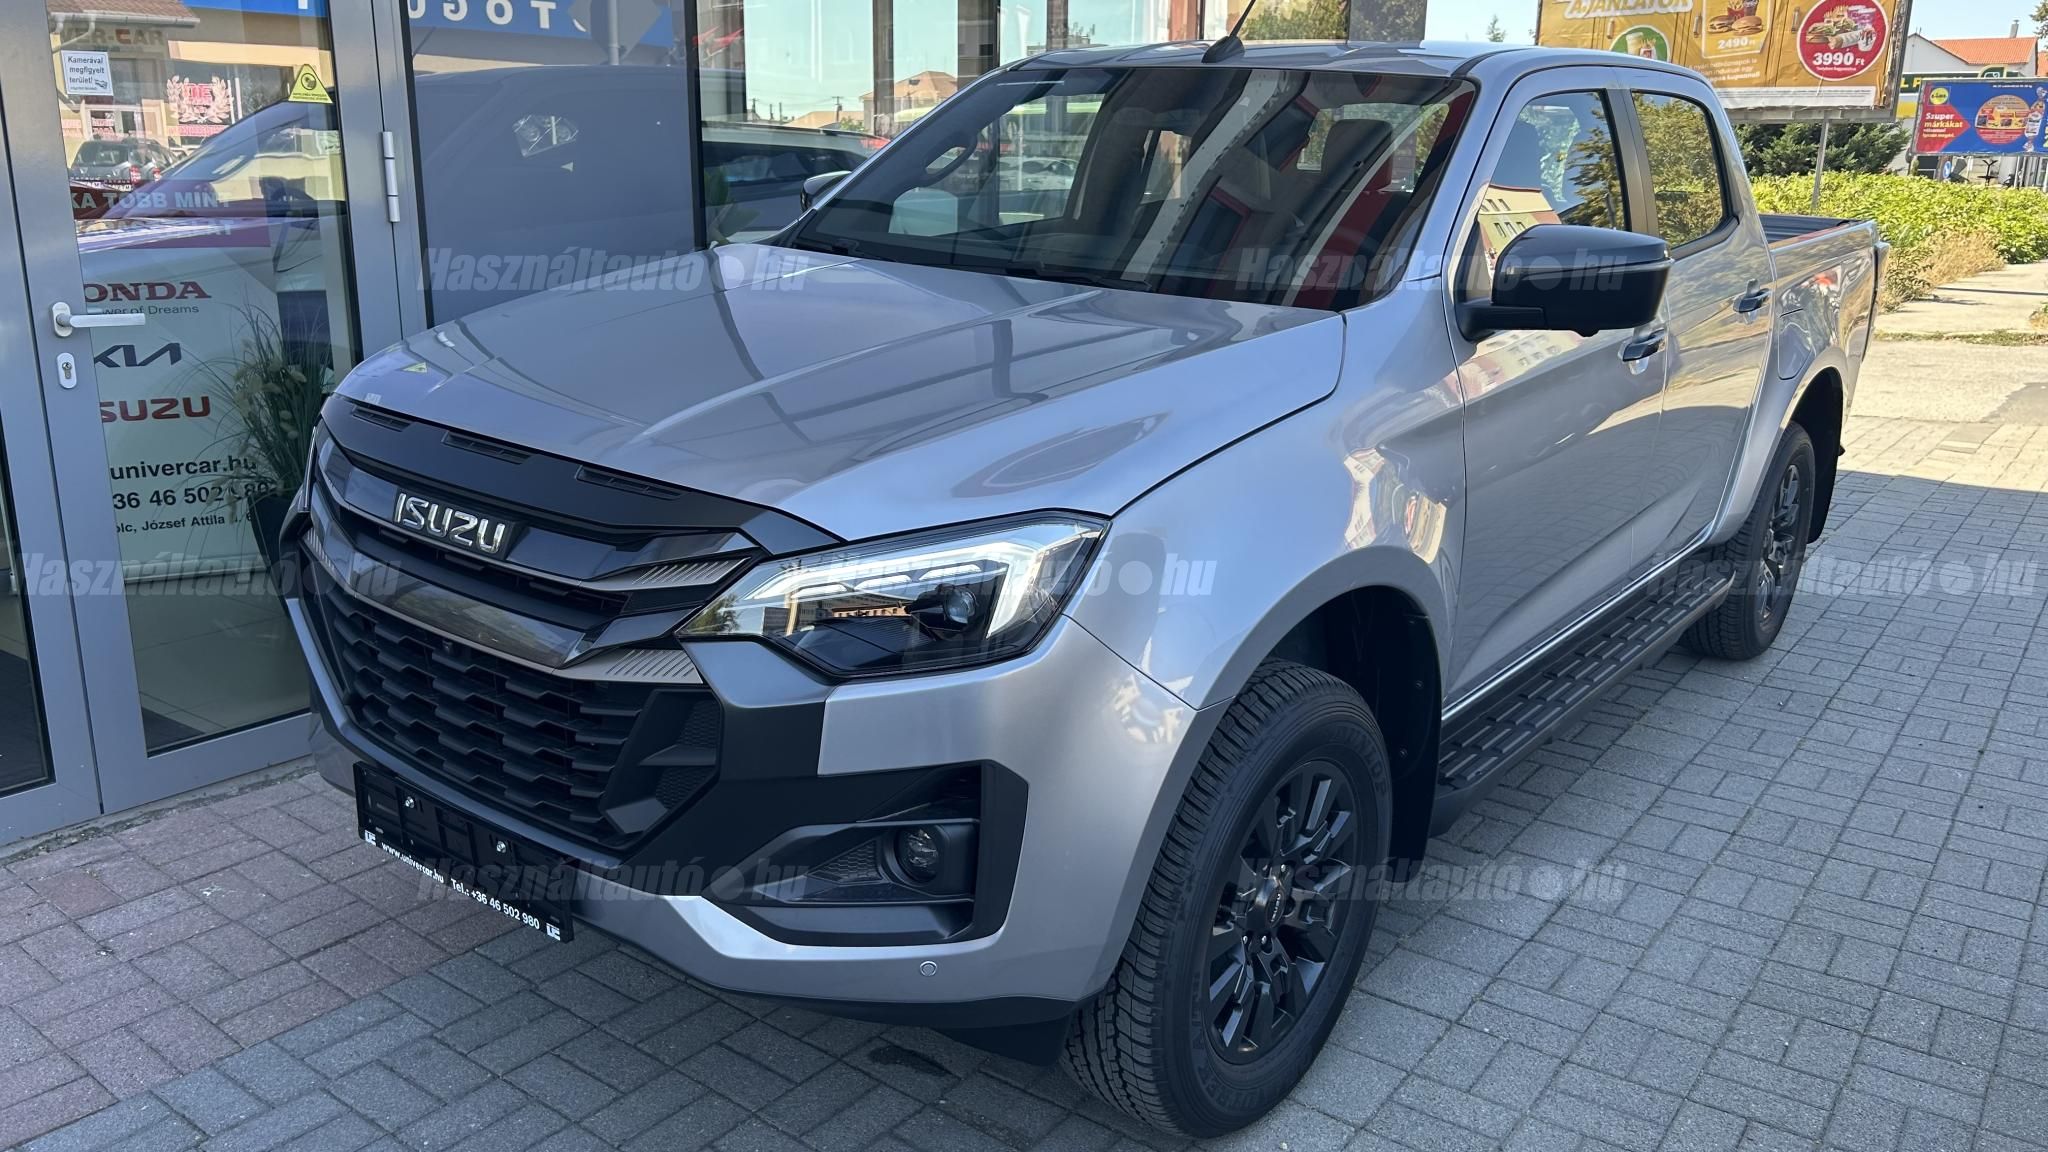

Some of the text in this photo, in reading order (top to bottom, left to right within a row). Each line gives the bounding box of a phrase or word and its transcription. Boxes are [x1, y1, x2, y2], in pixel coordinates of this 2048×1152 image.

[1717, 36, 1749, 50] 2490
[1812, 51, 1855, 66] 3990
[83, 281, 212, 303] ONDA
[148, 304, 200, 315] Dreams
[99, 396, 211, 423] SUZU
[150, 489, 177, 506] 46
[142, 517, 186, 532] József
[191, 514, 225, 527] Attila
[394, 492, 506, 554] ISUZU
[381, 842, 540, 931] www.univercar.hu Tel.: +36 46 502 980
